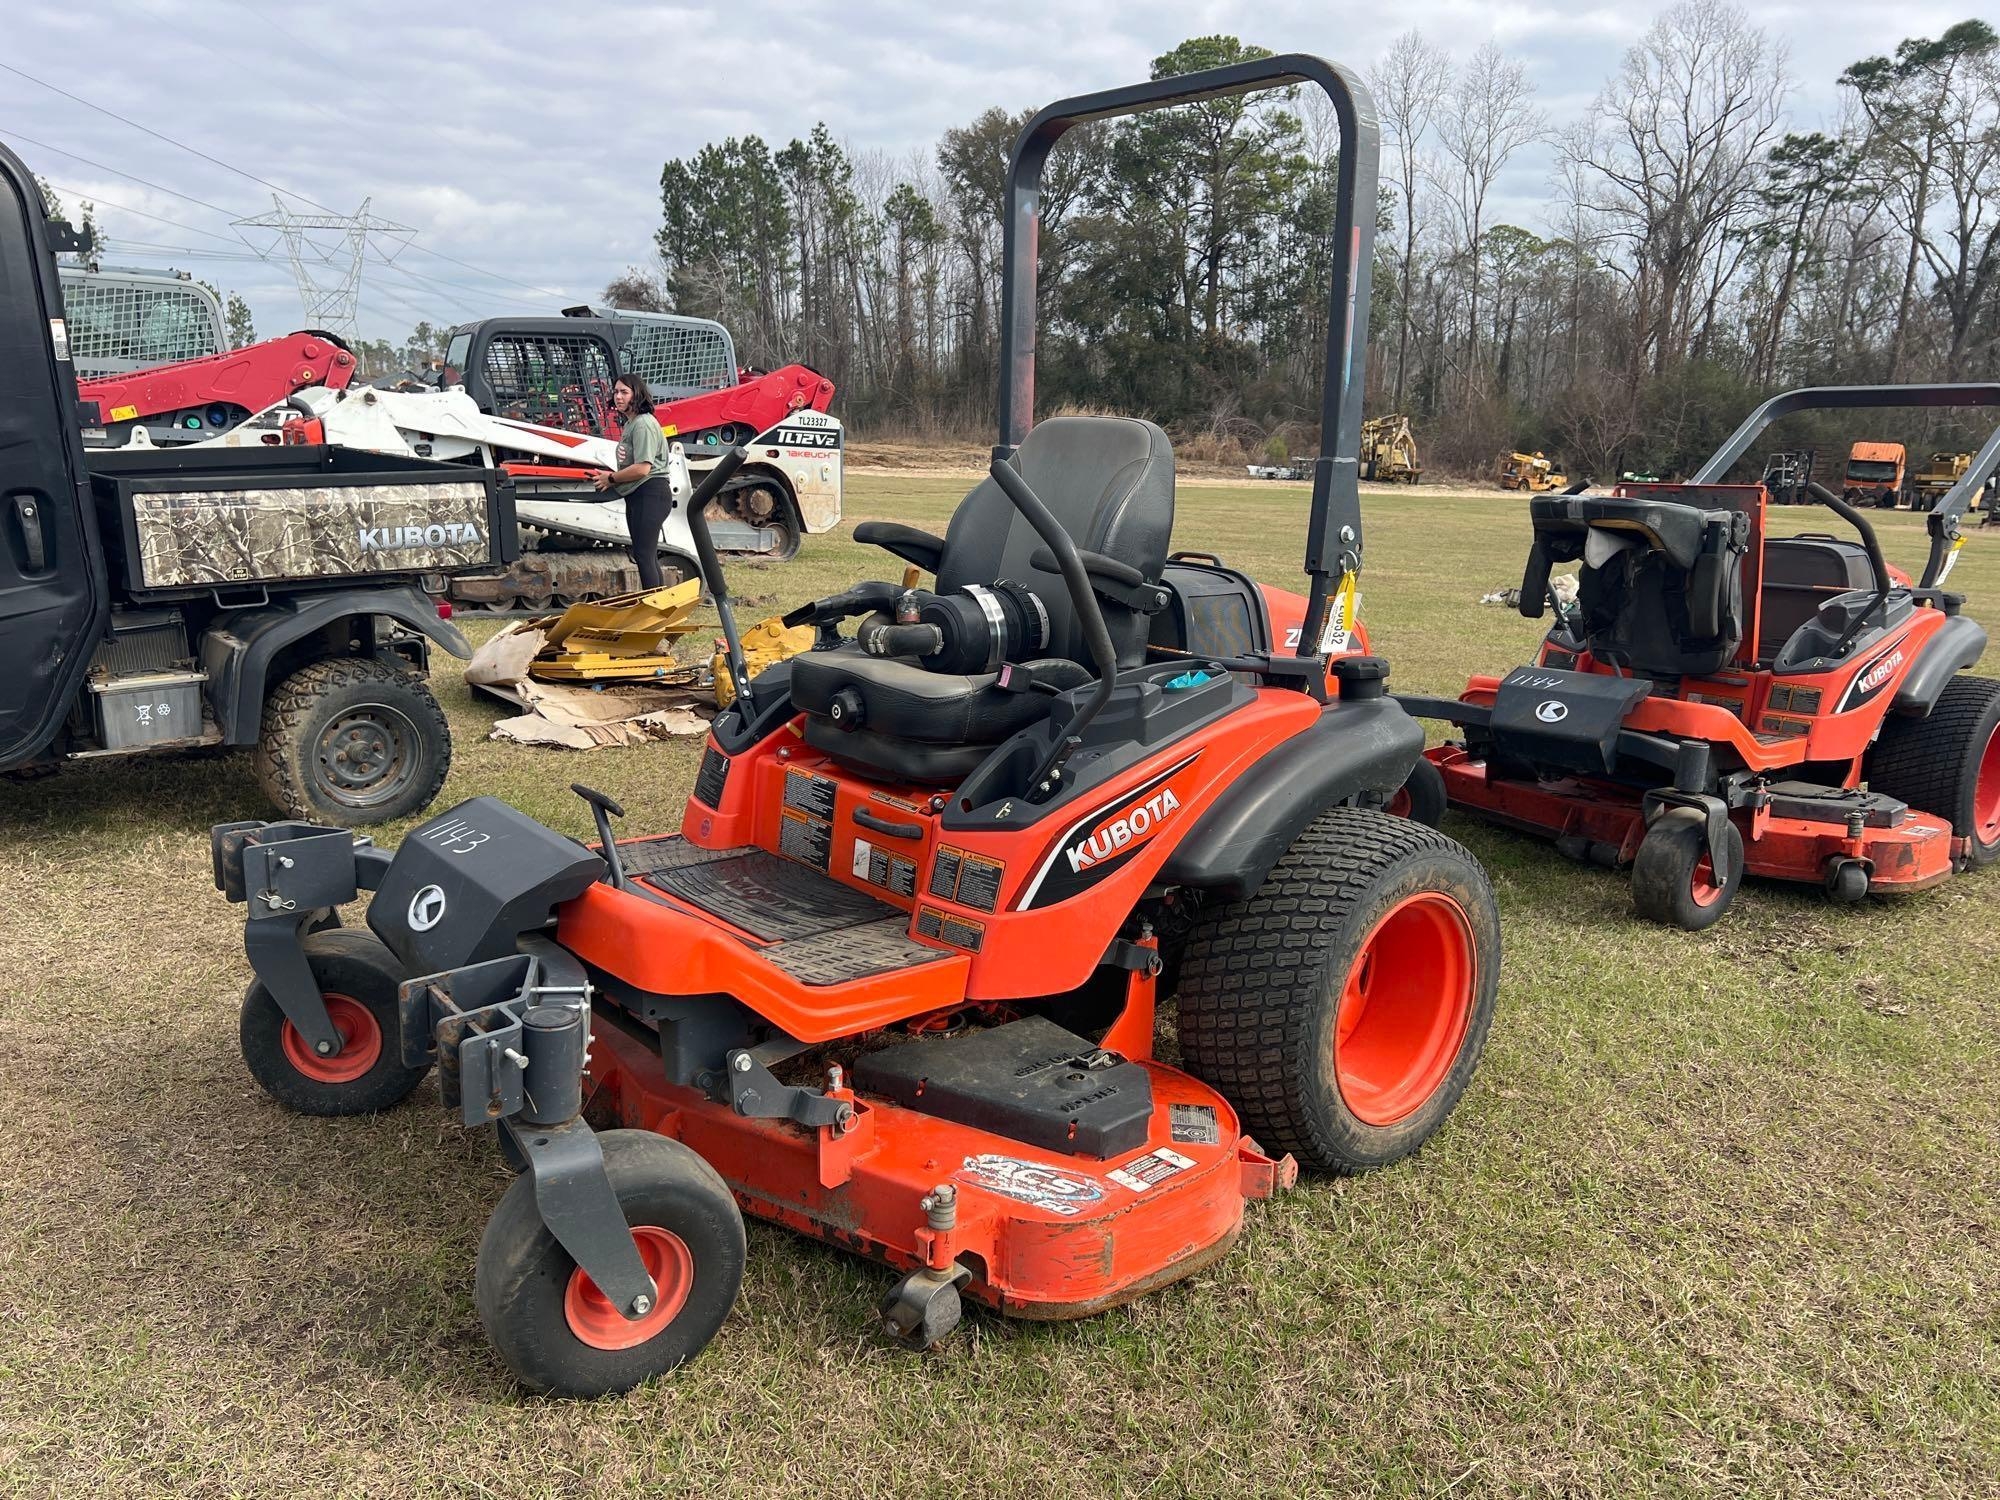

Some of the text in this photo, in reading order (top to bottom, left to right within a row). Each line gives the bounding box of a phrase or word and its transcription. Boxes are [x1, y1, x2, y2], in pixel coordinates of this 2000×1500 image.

[776, 428, 837, 447] TL12V2
[798, 416, 828, 427] TL23327
[359, 522, 482, 552] KUBOTA
[1857, 650, 1904, 694] KUBOTA
[420, 818, 491, 854] 1143
[1065, 787, 1181, 874] KUBOTA
